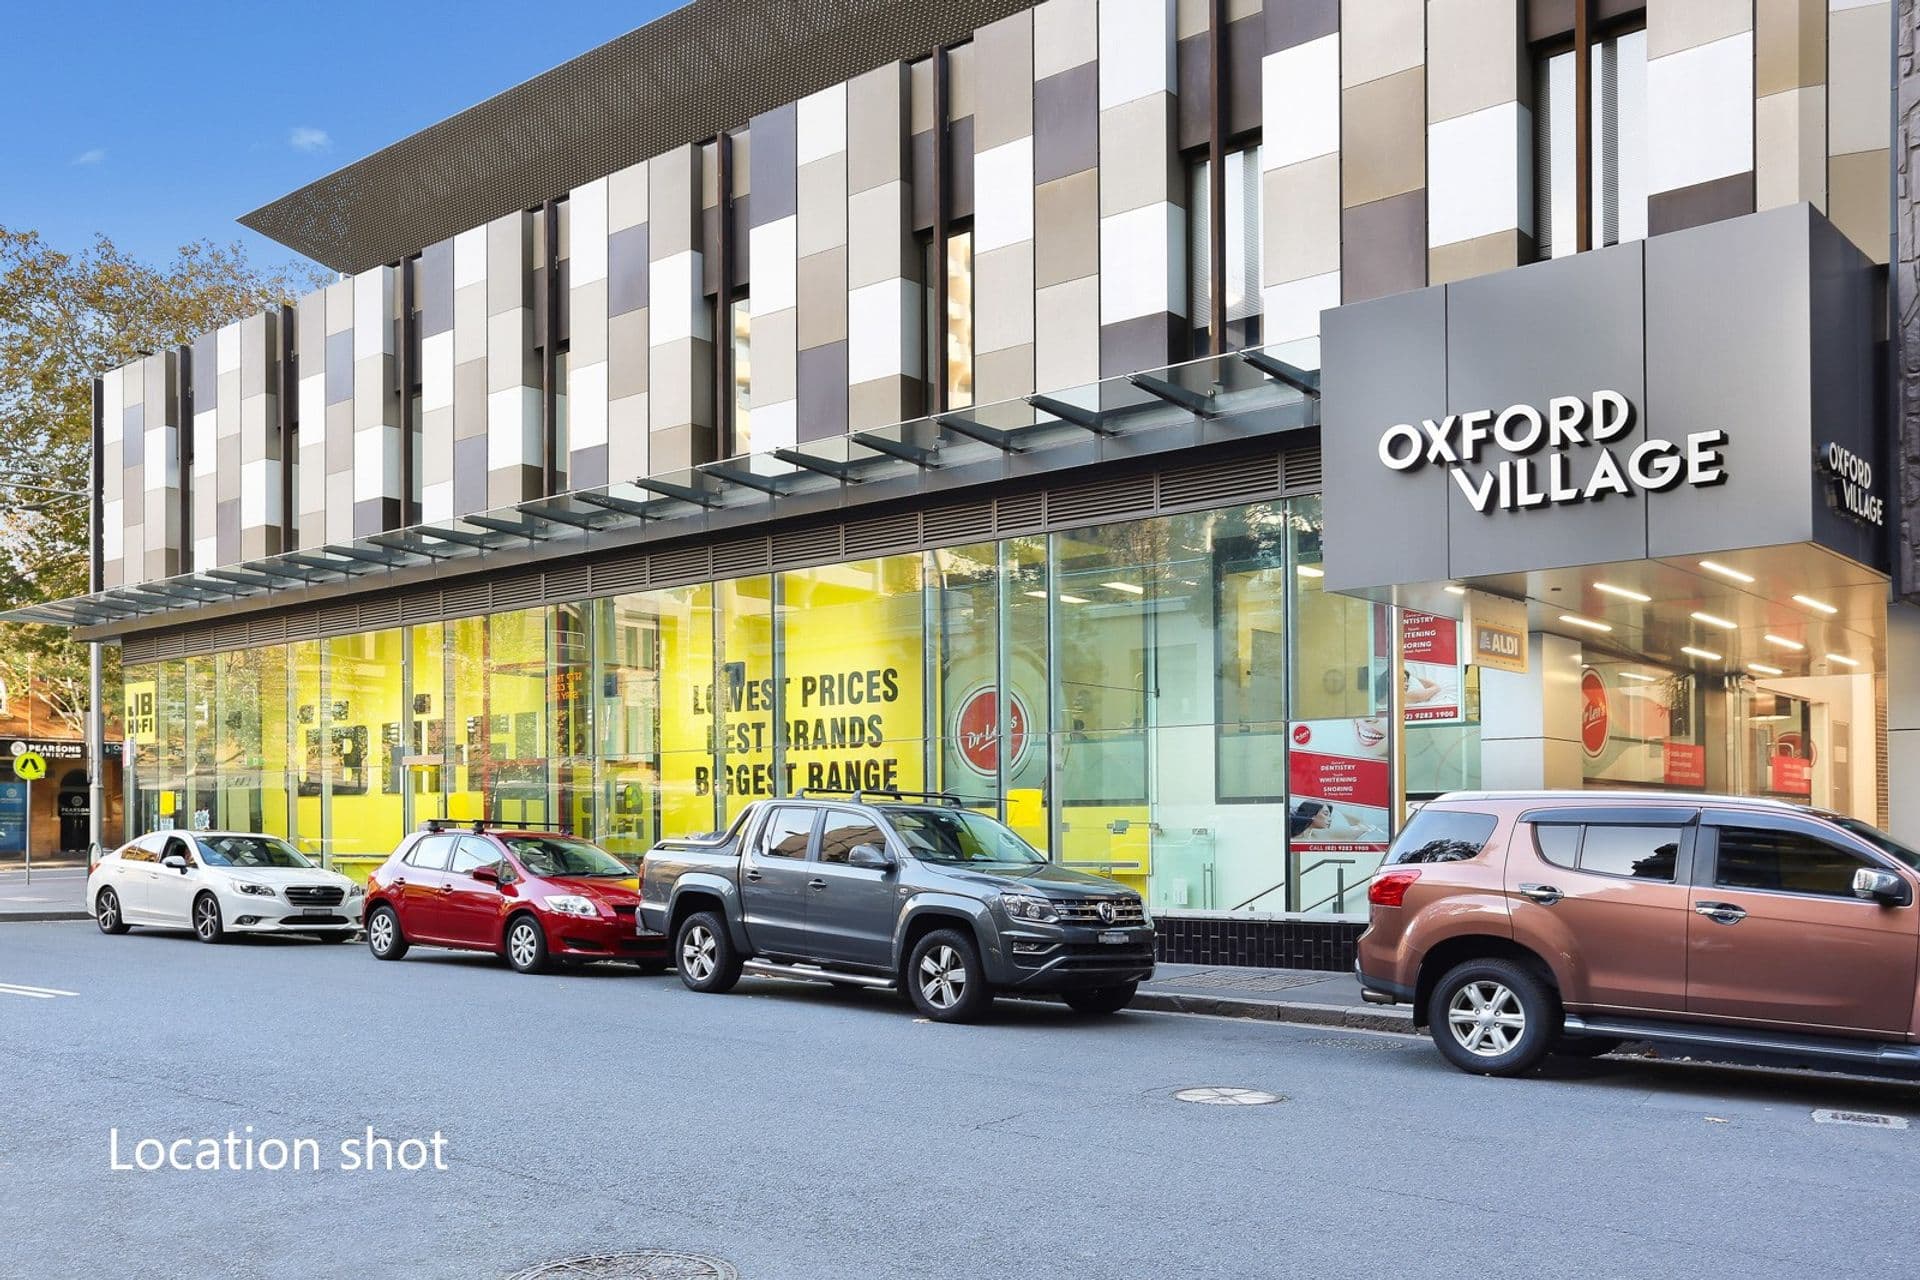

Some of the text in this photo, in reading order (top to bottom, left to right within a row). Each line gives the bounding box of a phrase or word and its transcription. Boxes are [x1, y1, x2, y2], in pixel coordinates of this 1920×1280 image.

[1378, 390, 1634, 471] OXFORD
[1451, 429, 1725, 512] VILLAGE
[1829, 442, 1871, 490] OXFORD
[1843, 478, 1883, 526] VILLAGE
[1403, 616, 1435, 624] NTISTRY
[1404, 630, 1436, 638] ITENING
[1491, 633, 1519, 656] ALDI
[128, 692, 152, 717] JB
[801, 668, 898, 707] PRICES
[28, 744, 82, 753] PEARSONS
[808, 759, 898, 793] RANGE
